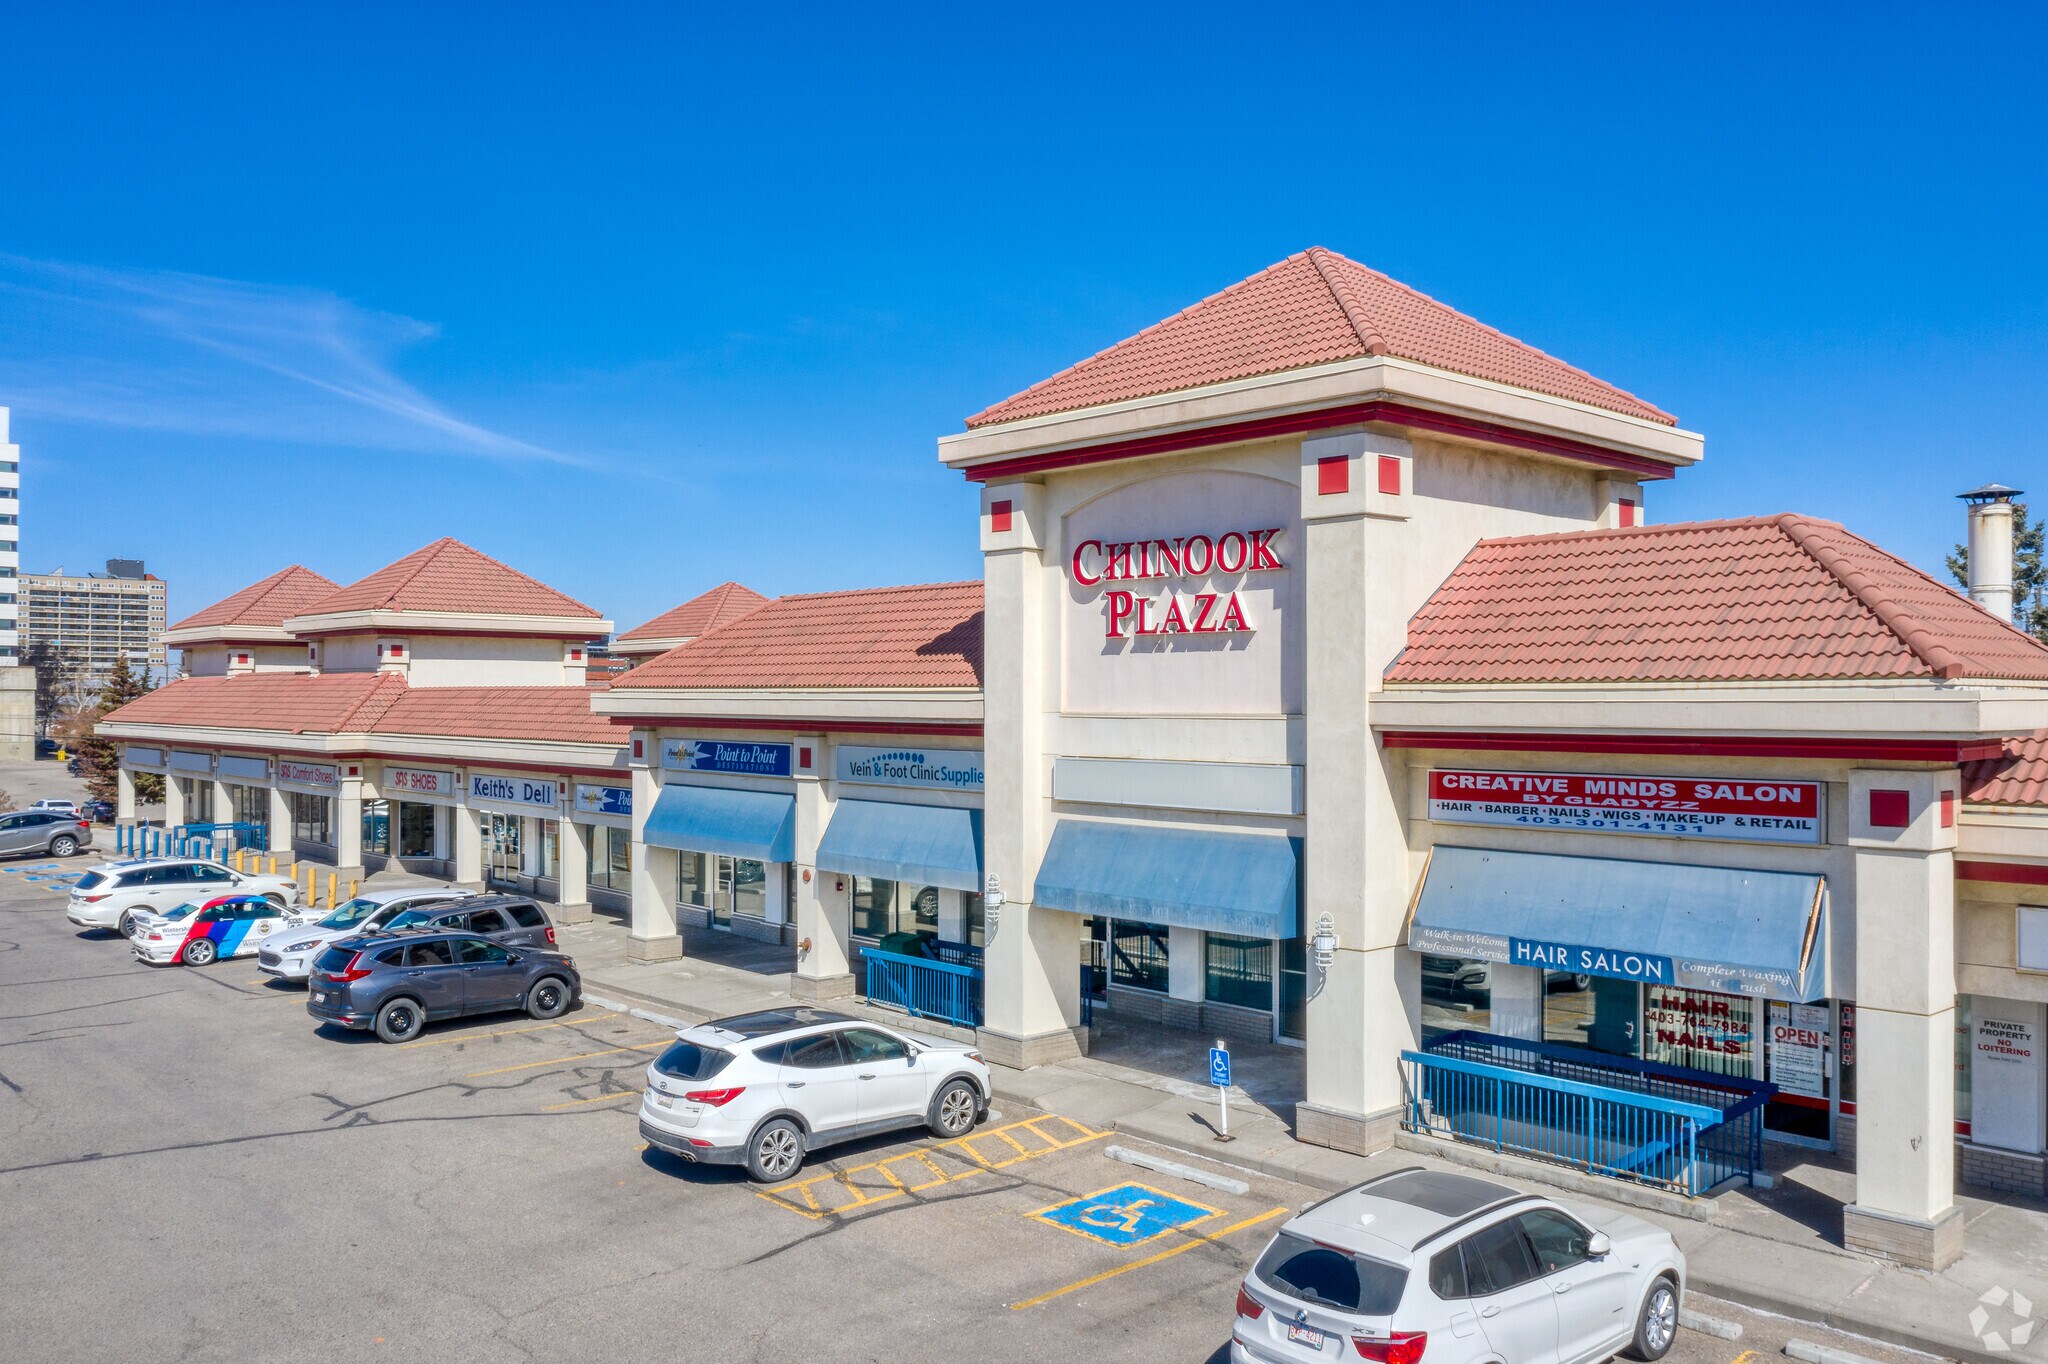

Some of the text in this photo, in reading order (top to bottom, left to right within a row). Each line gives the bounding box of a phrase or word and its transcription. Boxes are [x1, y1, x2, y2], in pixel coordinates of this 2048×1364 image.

[1072, 528, 1284, 587] CHINOOK
[1105, 591, 1251, 638] PLAZA
[715, 744, 778, 764] Point to Point
[292, 766, 314, 782] Comfort
[314, 768, 333, 784] Shoes
[717, 761, 775, 772] DESTINATIONS
[850, 762, 985, 786] Vein & Foot Clinic Supplie
[411, 774, 437, 791] SHOES
[474, 777, 551, 804] Keith's Deli
[1442, 774, 1801, 803] CREATIVE MINDS SALON
[1523, 794, 1700, 811] BY GLADYZZ
[1441, 802, 1812, 830] HAIR BARBER NAILS WIGS MAKE-UP & RETAIL
[1516, 815, 1703, 833] 403-301-4131
[1416, 940, 1474, 956] Professional
[1424, 928, 1509, 948] Walk-in Welcome
[1517, 942, 1662, 979] HAIR SALON
[1662, 994, 1730, 1017] HAIR
[1648, 1011, 1748, 1035] 403-764-7984
[1983, 1020, 2025, 1032] PRIVATE
[1656, 1029, 1741, 1055] NAILS
[1774, 1026, 1819, 1045] OPEN
[1979, 1028, 2032, 1041] PROPERTY
[1997, 1039, 2012, 1047] NO
[1977, 1044, 2031, 1057] LOITERING
